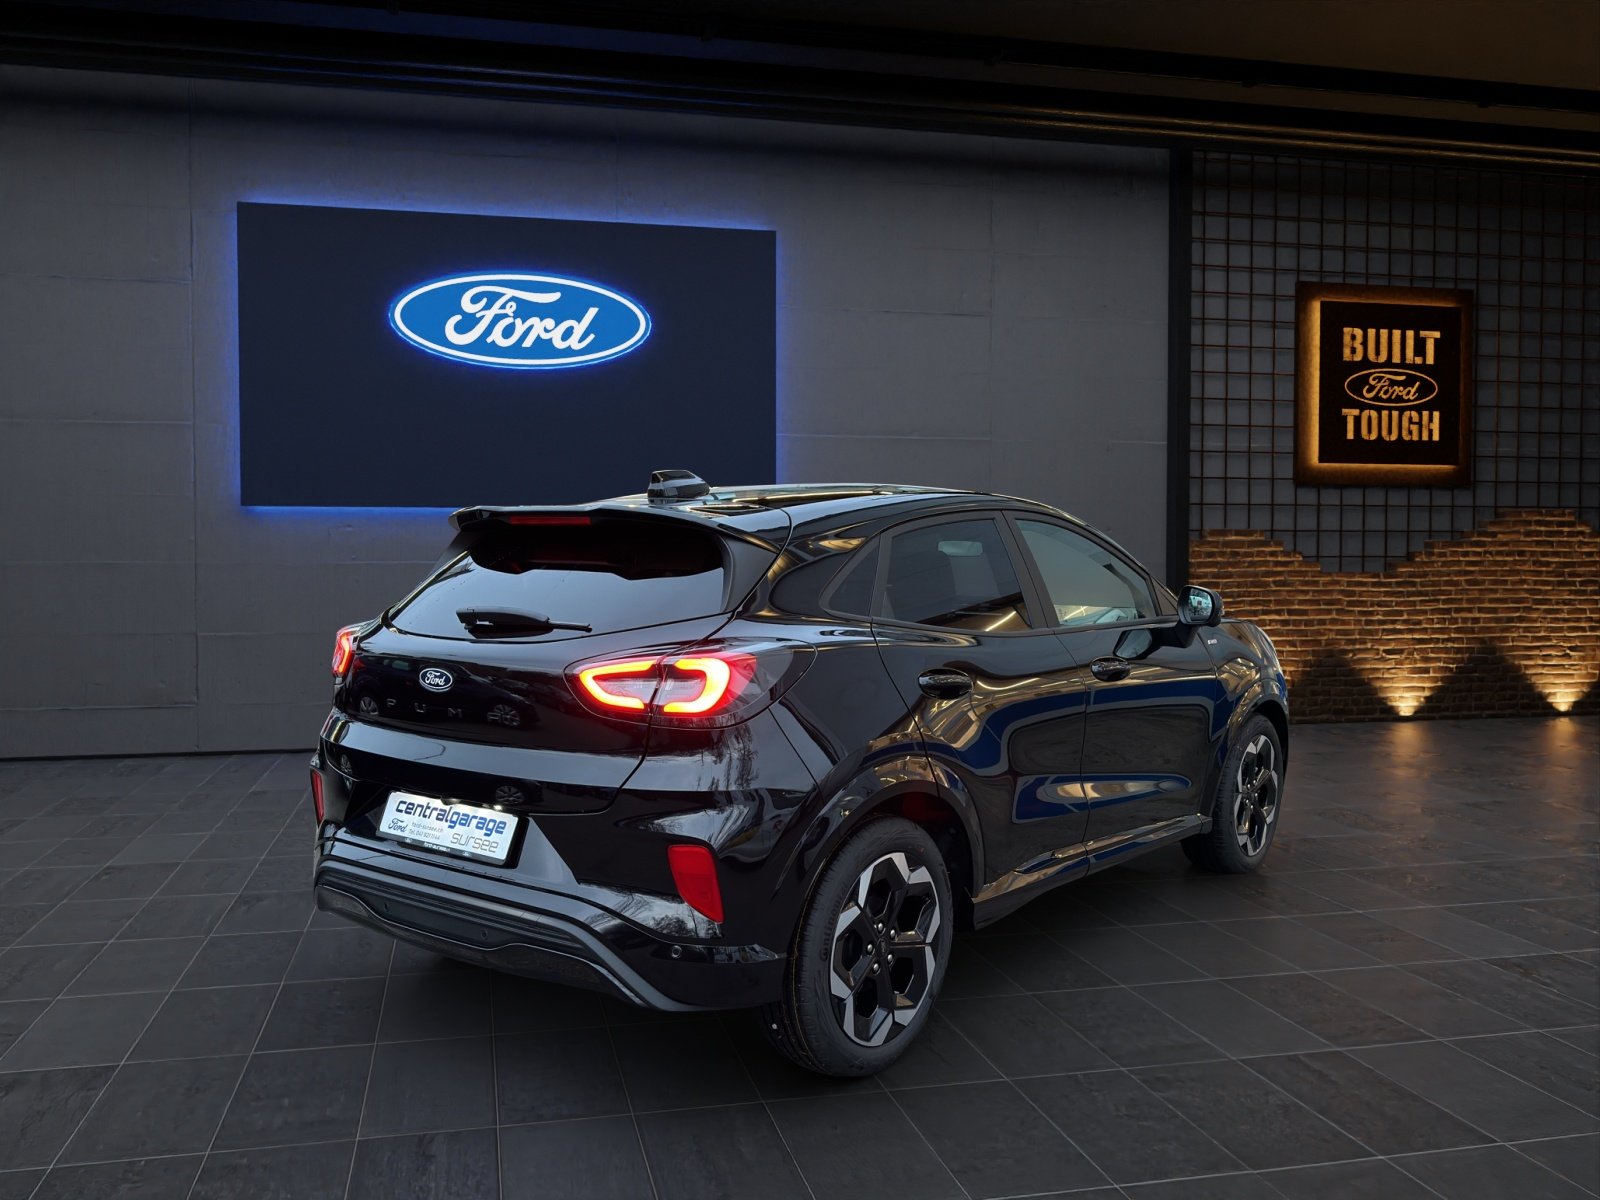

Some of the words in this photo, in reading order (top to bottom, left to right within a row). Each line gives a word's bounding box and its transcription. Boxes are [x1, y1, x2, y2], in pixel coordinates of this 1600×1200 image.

[444, 285, 600, 351] Ford
[1342, 327, 1441, 365] BUILT
[1362, 373, 1420, 401] Ford
[1341, 408, 1441, 442] TOUGH
[425, 670, 446, 687] Ford
[386, 698, 501, 723] PUMA
[388, 817, 408, 833] Ford
[395, 800, 507, 837] centralgarage
[450, 832, 499, 854] sursee
